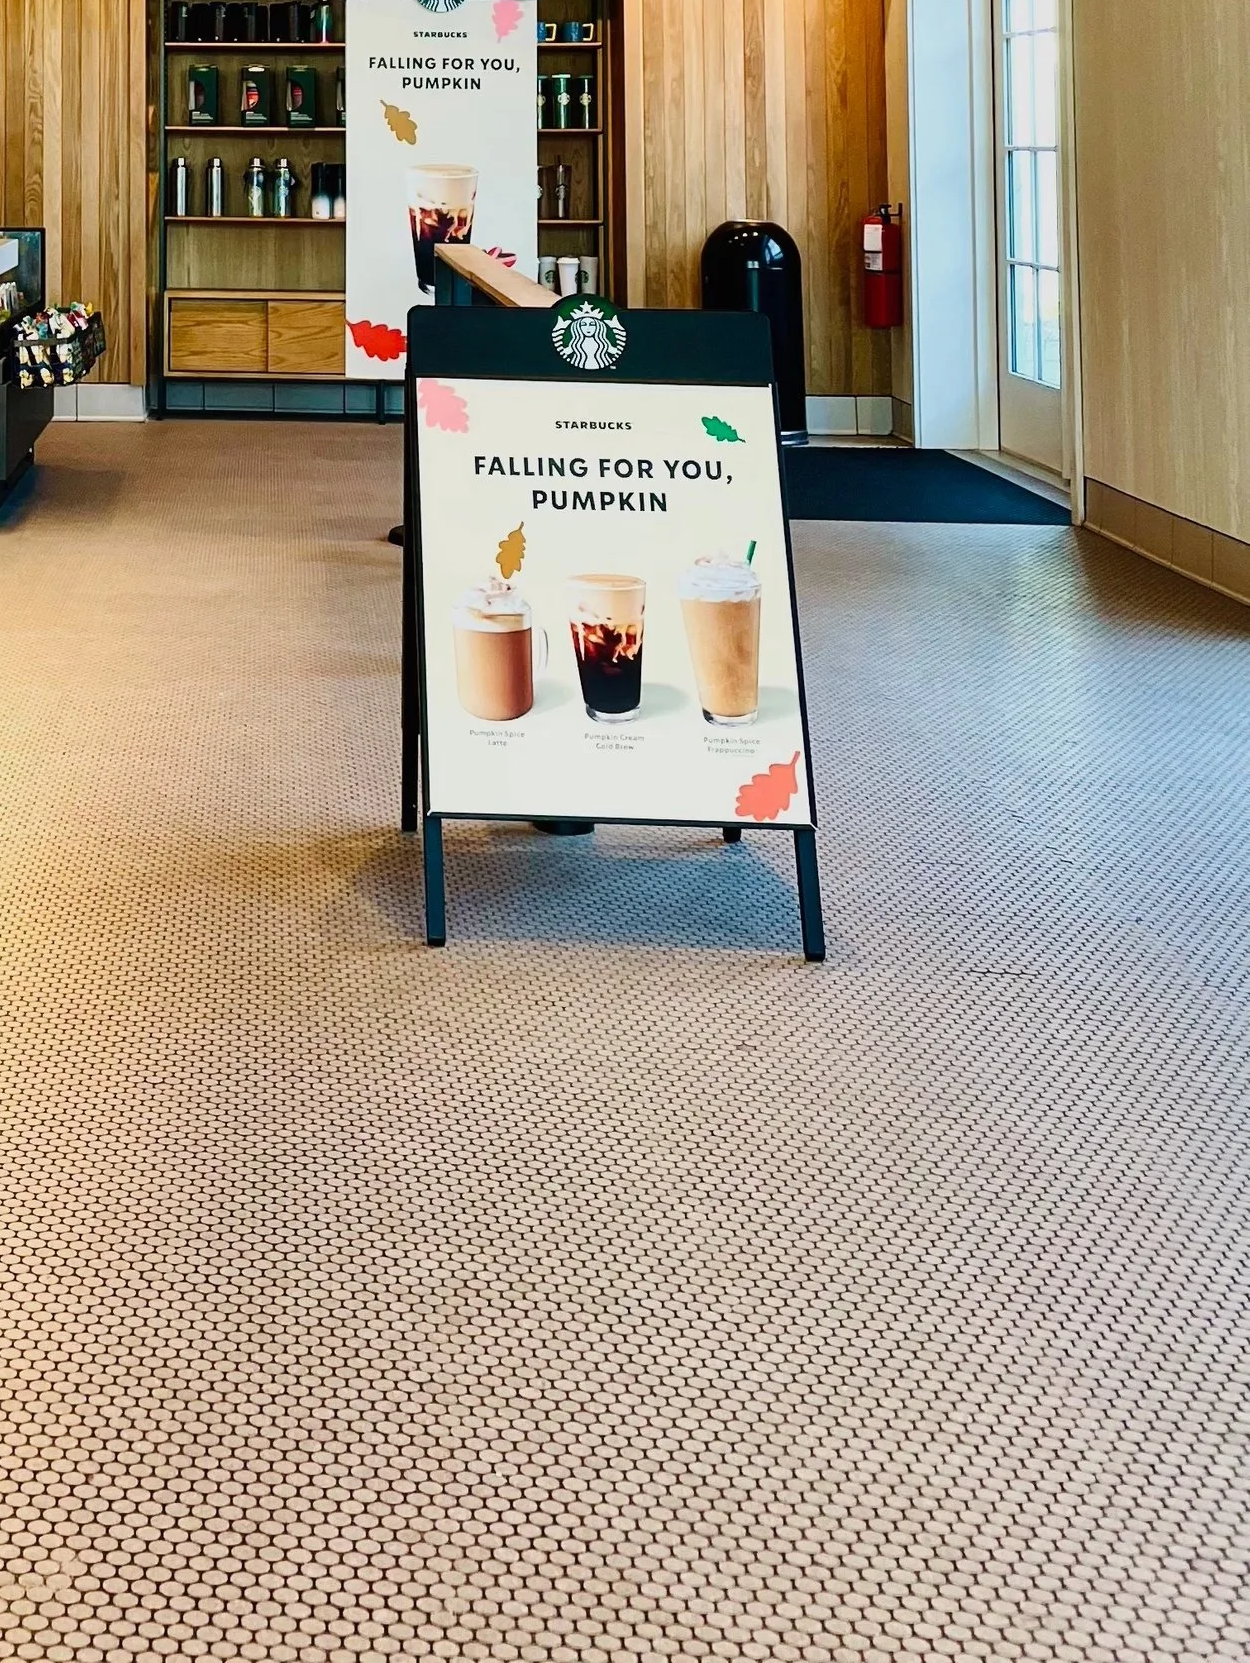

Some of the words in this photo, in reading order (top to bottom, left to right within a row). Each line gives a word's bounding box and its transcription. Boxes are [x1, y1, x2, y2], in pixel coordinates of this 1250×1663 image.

[369, 57, 437, 70] FALLING
[442, 58, 475, 70] FOR
[480, 58, 520, 73] YOU,
[402, 77, 481, 90] PUMPKIN
[555, 420, 633, 431] STARBUCKS
[474, 455, 589, 478] FALLING
[599, 458, 654, 479] FOR
[663, 459, 733, 485] YOU,
[532, 489, 668, 513] PUMPKIN
[469, 729, 502, 739] Pumpkin
[504, 731, 526, 739] Spice
[584, 732, 618, 742] Pumpkin
[703, 736, 738, 745] Pumpkin
[595, 742, 613, 750] Cold
[707, 746, 756, 754] Frappuccino
